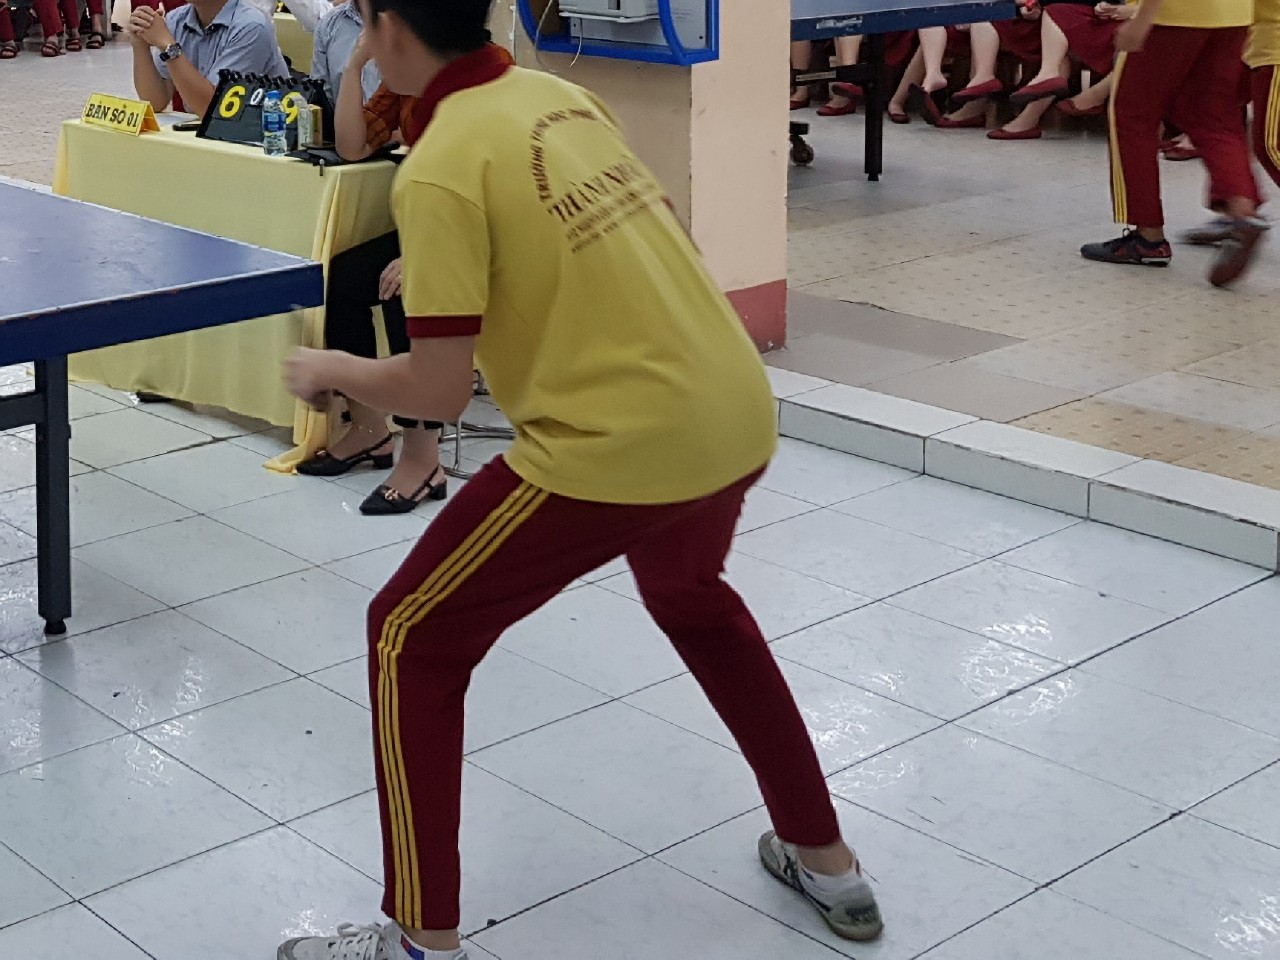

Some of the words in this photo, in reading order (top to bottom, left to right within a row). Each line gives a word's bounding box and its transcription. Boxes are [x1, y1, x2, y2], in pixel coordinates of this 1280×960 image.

[86, 100, 111, 121] BÀN
[127, 112, 139, 128] 01
[220, 85, 246, 118] 6
[250, 88, 264, 106] 0
[281, 91, 303, 124] 9
